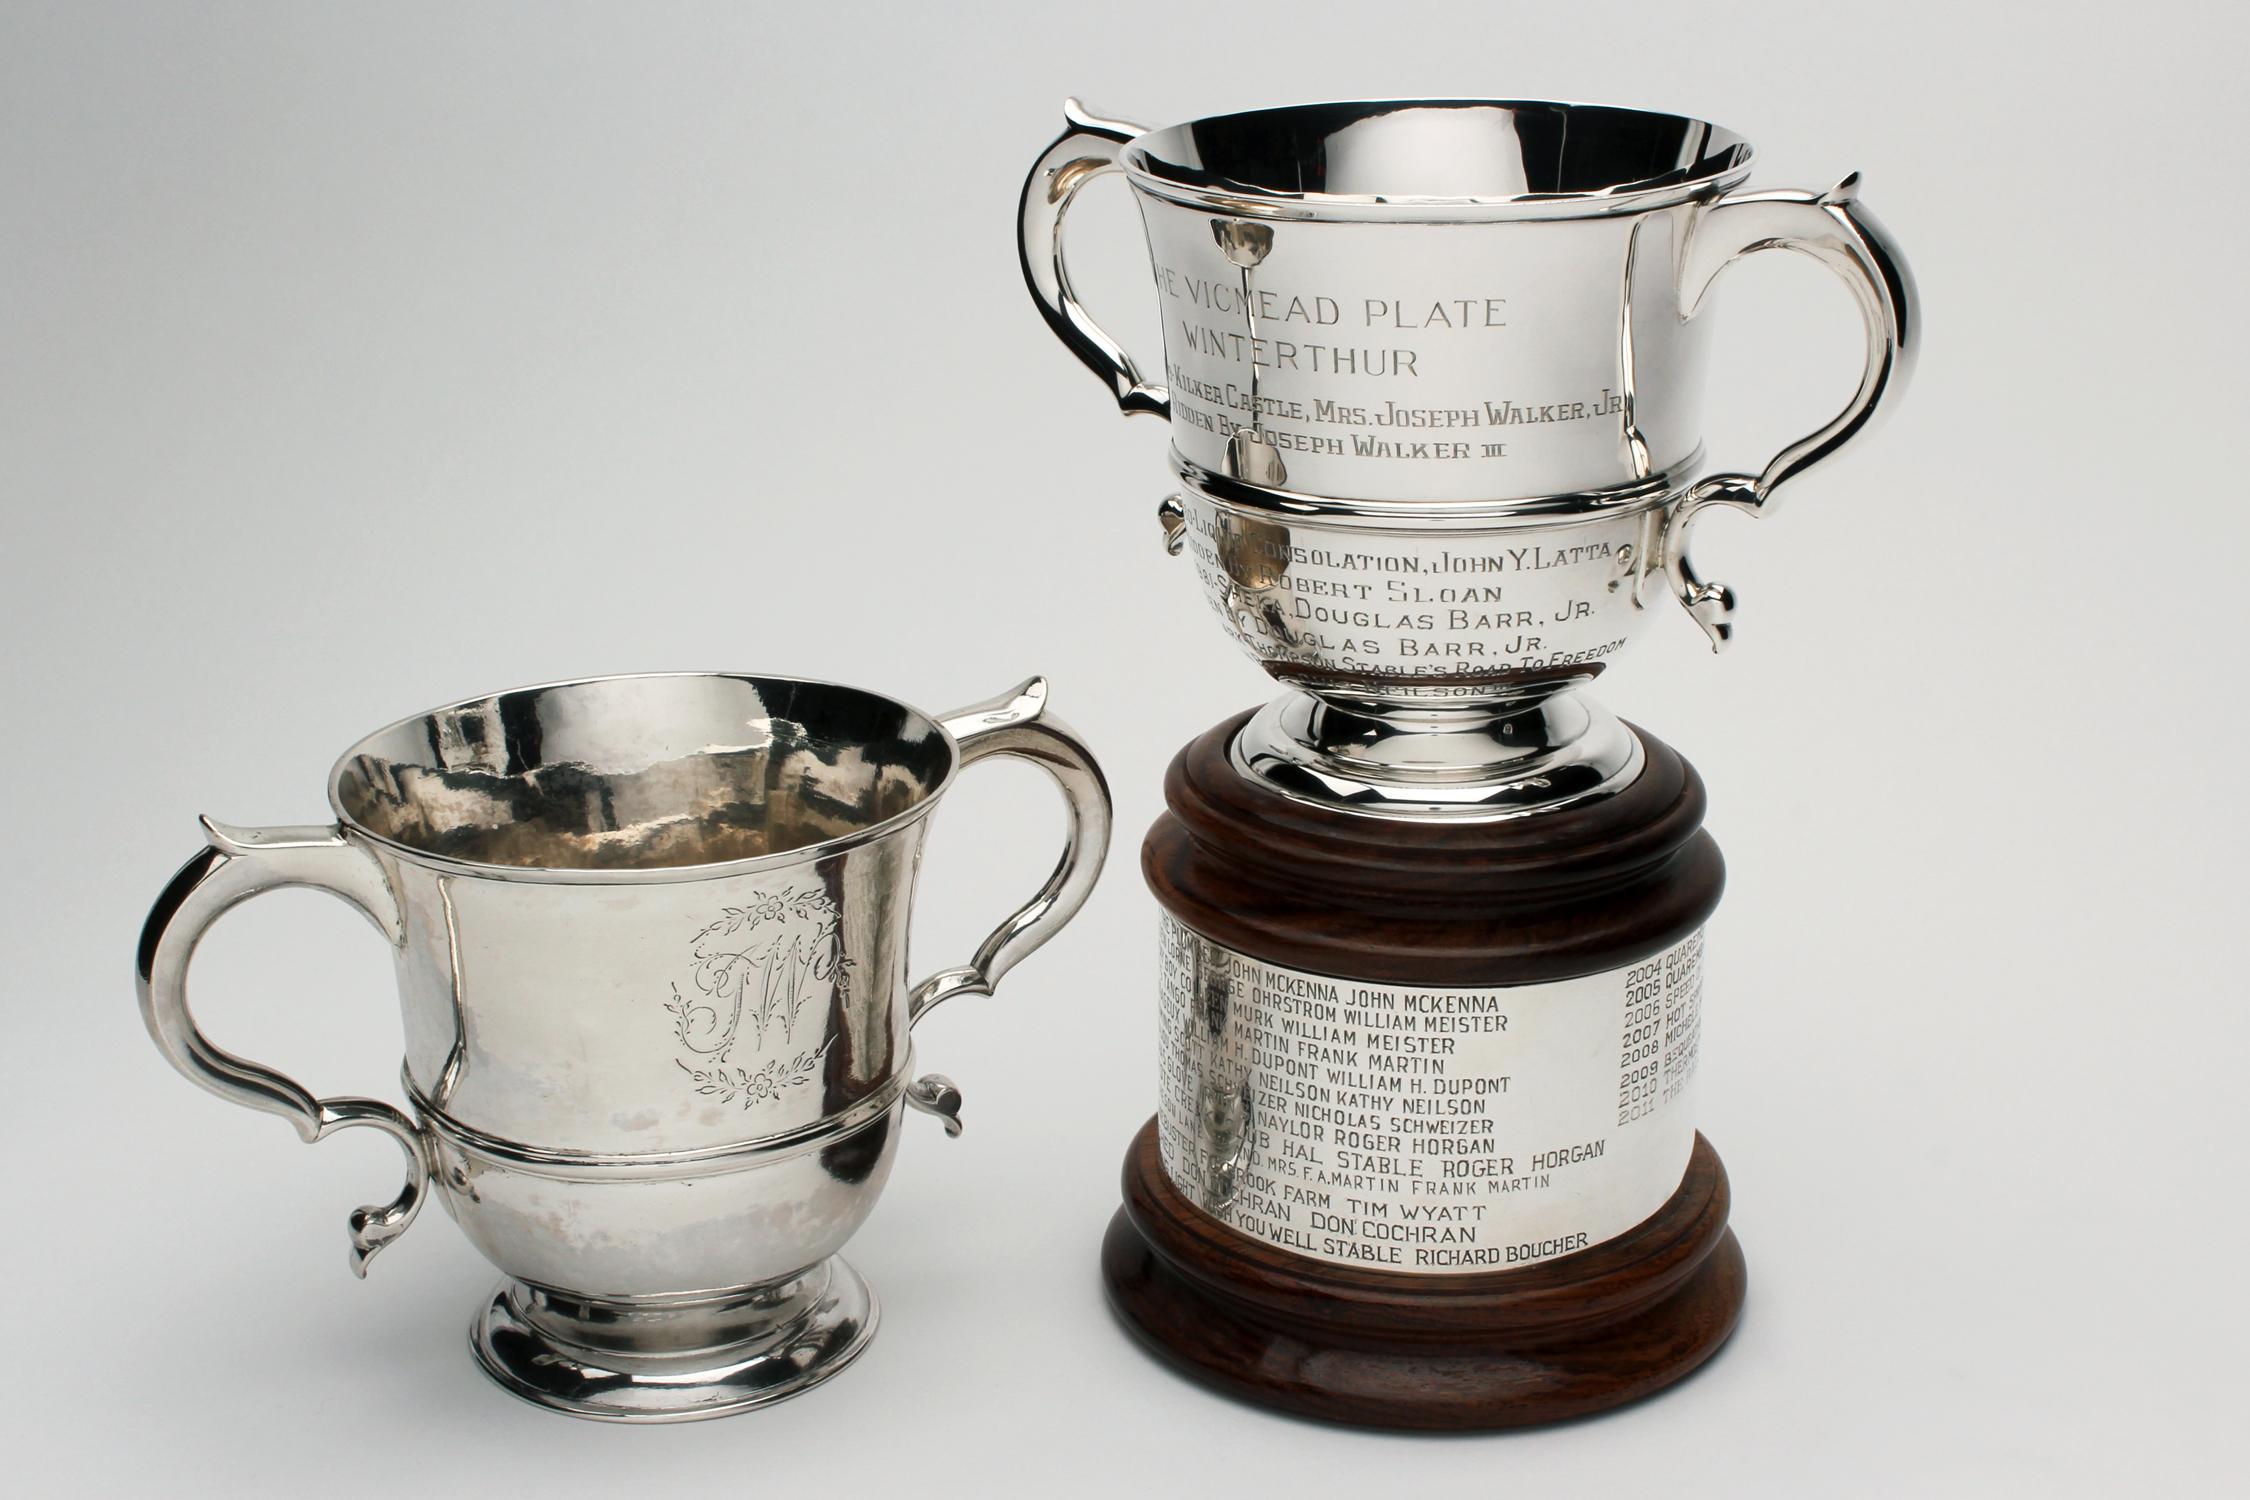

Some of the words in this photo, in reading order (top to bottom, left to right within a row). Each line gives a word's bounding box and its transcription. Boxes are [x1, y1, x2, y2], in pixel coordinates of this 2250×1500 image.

[1157, 262, 1179, 298] HE
[1185, 275, 1340, 326] VICMEAD
[1365, 298, 1507, 328] PLATE
[1182, 320, 1418, 377] WINTERTHUR
[1313, 399, 1372, 426] MRS.
[1375, 400, 1480, 428] JOSEPH
[1484, 400, 1591, 427] WALKER,
[1248, 421, 1343, 455] JOSEPH
[1350, 433, 1470, 459] WALKER
[1432, 551, 1503, 573] JOHN
[1259, 563, 1372, 600] ROBERT
[1387, 580, 1502, 603] SLOAN
[1295, 597, 1434, 630] DOUGLAS
[1448, 609, 1544, 630] BARR,
[1555, 600, 1595, 622] JR.
[1255, 615, 1380, 654] DOUGLAS
[1399, 638, 1497, 657] BARR,
[1505, 635, 1547, 654] JR.
[1456, 661, 1512, 677] ROAD
[1548, 636, 1627, 669] FREEDOM
[1225, 956, 1262, 985] JOHN
[1265, 971, 1339, 1003] MCKENNA
[1346, 989, 1395, 1010] JOHN
[1404, 994, 1499, 1014] MCKENNA
[1625, 958, 1662, 988] 2004
[1252, 987, 1336, 1023] OHRSTROM
[1344, 1008, 1416, 1032] WILLIAM
[1424, 1015, 1508, 1033] MEISTER
[1626, 979, 1661, 1007] 2005
[1233, 1001, 1274, 1028] MURK
[1282, 1017, 1356, 1046] WILLIAM
[1367, 1033, 1455, 1055] MEISTER
[1622, 1018, 1661, 1048] 2007
[1625, 1000, 1660, 1028] 2006
[1234, 1021, 1289, 1054] MARTIN
[1298, 1041, 1358, 1067] FRANK
[1368, 1054, 1445, 1075] MARTIN
[1620, 1040, 1659, 1068] 2008
[1211, 1050, 1253, 1082] KATHY
[1259, 1071, 1330, 1104] NEILSON
[1337, 1090, 1394, 1112] KATHY
[1402, 1098, 1486, 1116] NEILSON
[1252, 1047, 1319, 1080] DUPONT
[1327, 1068, 1402, 1093] WILLIAM
[1434, 1076, 1511, 1095] DUPONT
[1620, 1060, 1658, 1089] 2009
[1618, 1078, 1657, 1109] 2010
[1295, 1101, 1381, 1130] NICHOLAS
[1390, 1117, 1494, 1135] SCHWEIZER
[1618, 1099, 1655, 1127] 2011
[1258, 1110, 1324, 1142] NAYLOR
[1334, 1128, 1401, 1152] ROGER
[1413, 1138, 1495, 1156] HORGAN
[1282, 1139, 1333, 1165] HAL
[1337, 1150, 1423, 1178] STABLE
[1442, 1157, 1514, 1178] ROGER
[1531, 1139, 1607, 1172] HORGAN
[1284, 1184, 1331, 1209] FARM
[1347, 1198, 1387, 1218] TIM
[1400, 1204, 1487, 1222] WYATT
[1412, 1180, 1477, 1195] FRANK
[1488, 1174, 1551, 1194] MARTIN
[1236, 1209, 1265, 1237] YOU
[1269, 1222, 1318, 1251] WELL
[1323, 1238, 1402, 1265] STABLE
[1415, 1247, 1500, 1266] RICHARD
[1506, 1231, 1589, 1263] BOUCHER
[1311, 1211, 1355, 1236] DON
[1362, 1220, 1476, 1243] COCHRAN
